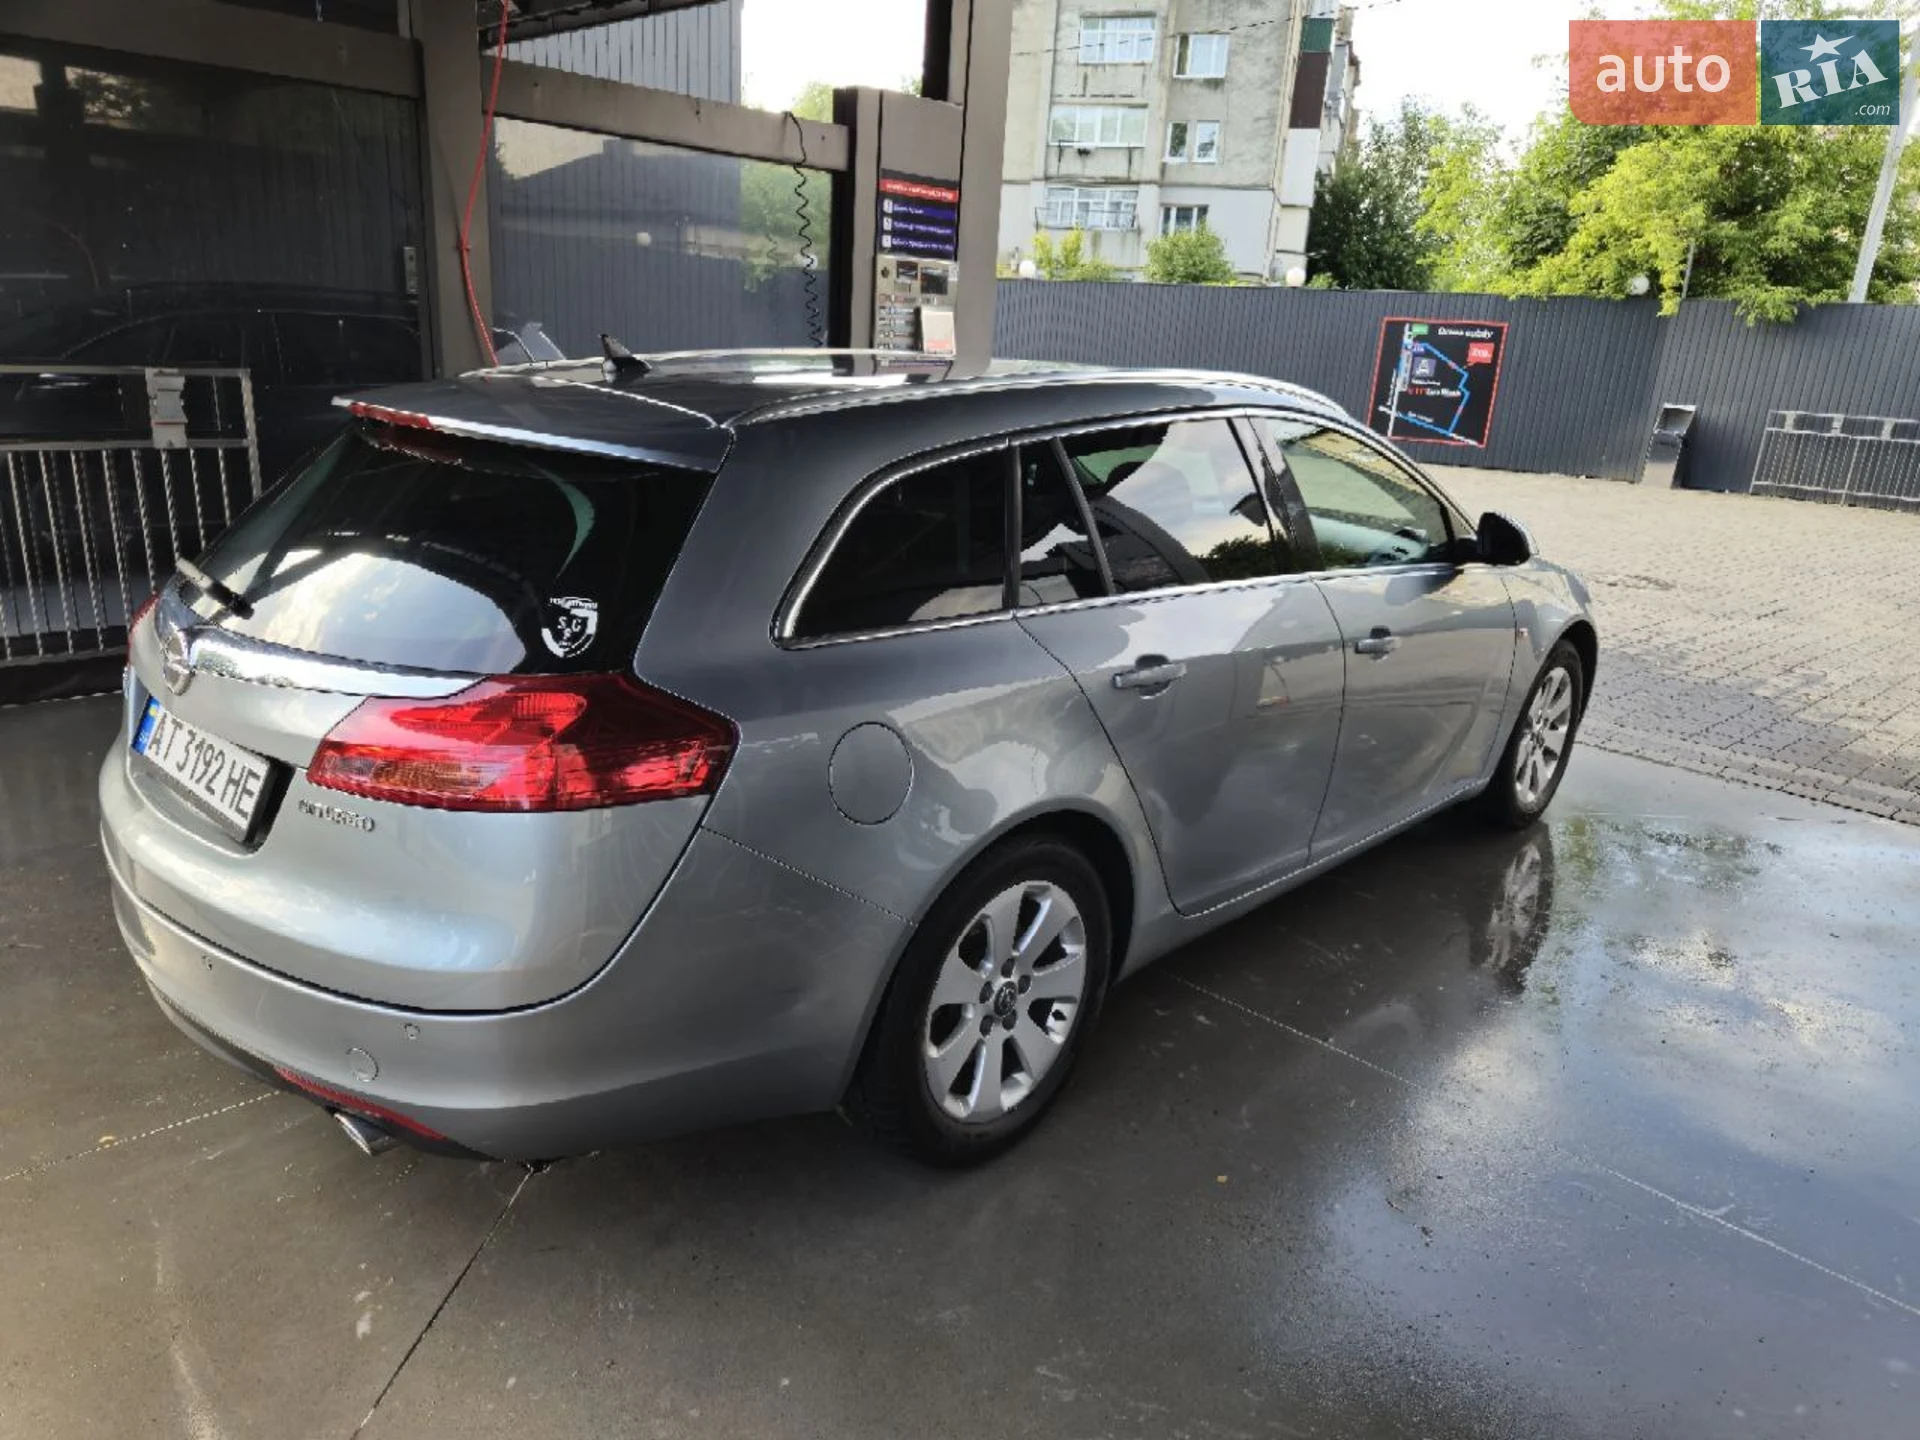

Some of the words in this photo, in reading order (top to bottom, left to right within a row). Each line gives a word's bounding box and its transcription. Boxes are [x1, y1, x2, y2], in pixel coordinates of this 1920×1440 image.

[148, 713, 183, 762] AT
[176, 729, 226, 796] 3192
[220, 760, 261, 821] HE
